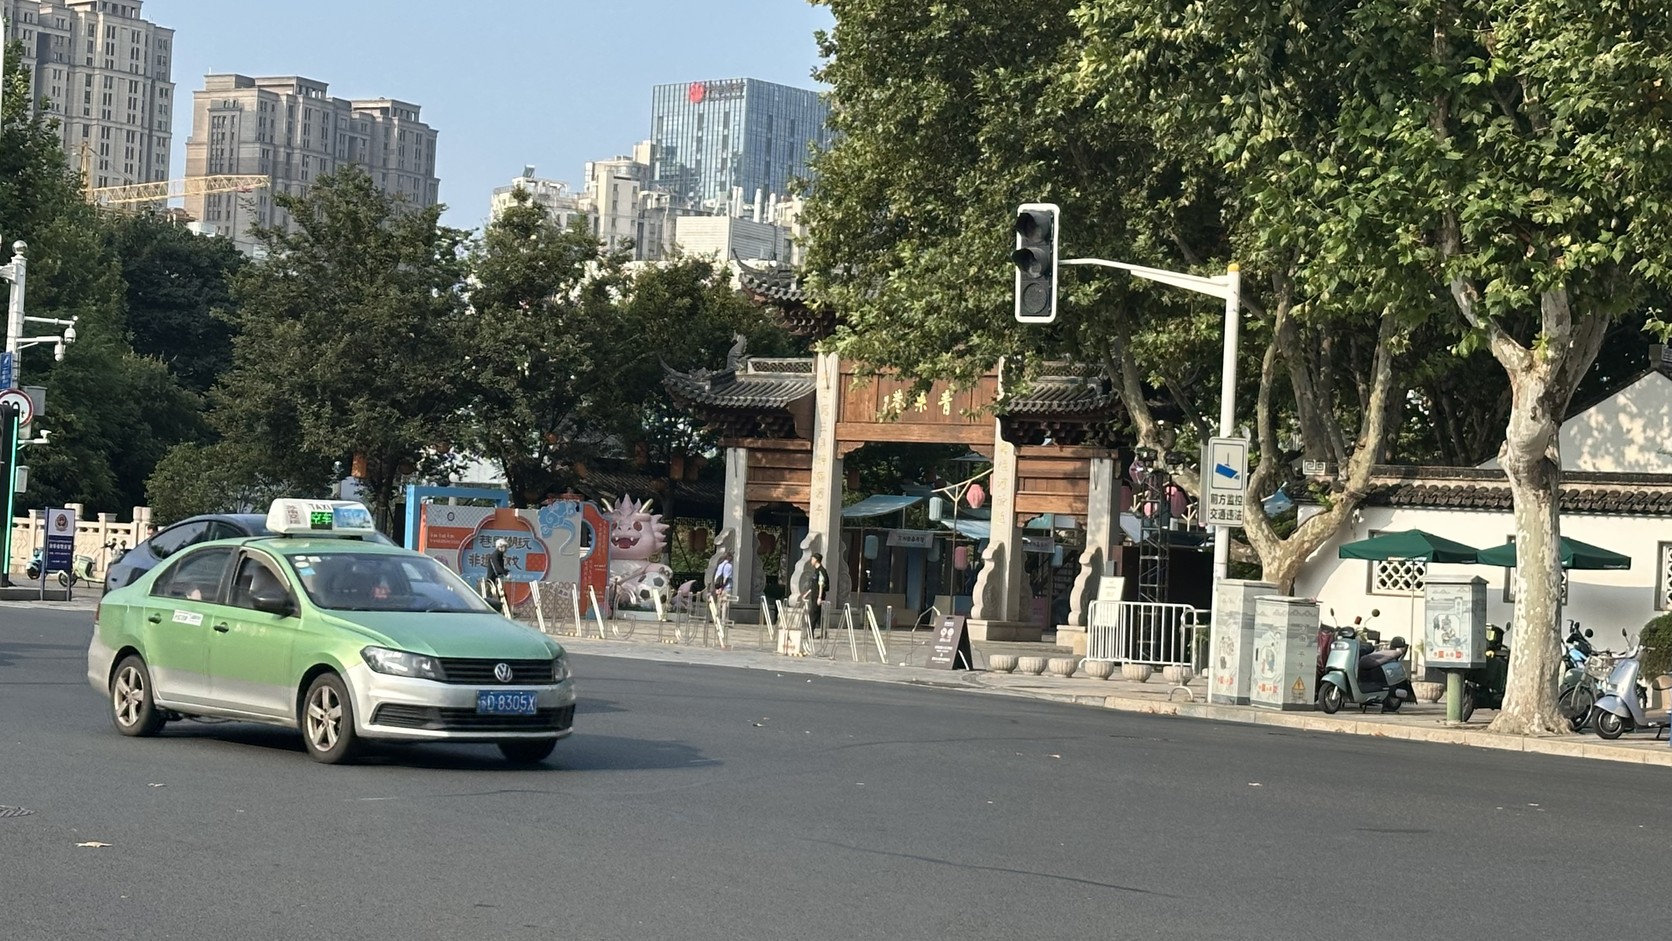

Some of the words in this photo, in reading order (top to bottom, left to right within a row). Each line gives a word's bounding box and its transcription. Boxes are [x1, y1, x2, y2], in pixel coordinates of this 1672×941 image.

[1211, 494, 1242, 505] 前方监控
[311, 513, 331, 524] 空车
[1210, 508, 1242, 520] 交通违法
[468, 553, 522, 571] 非遗戏
